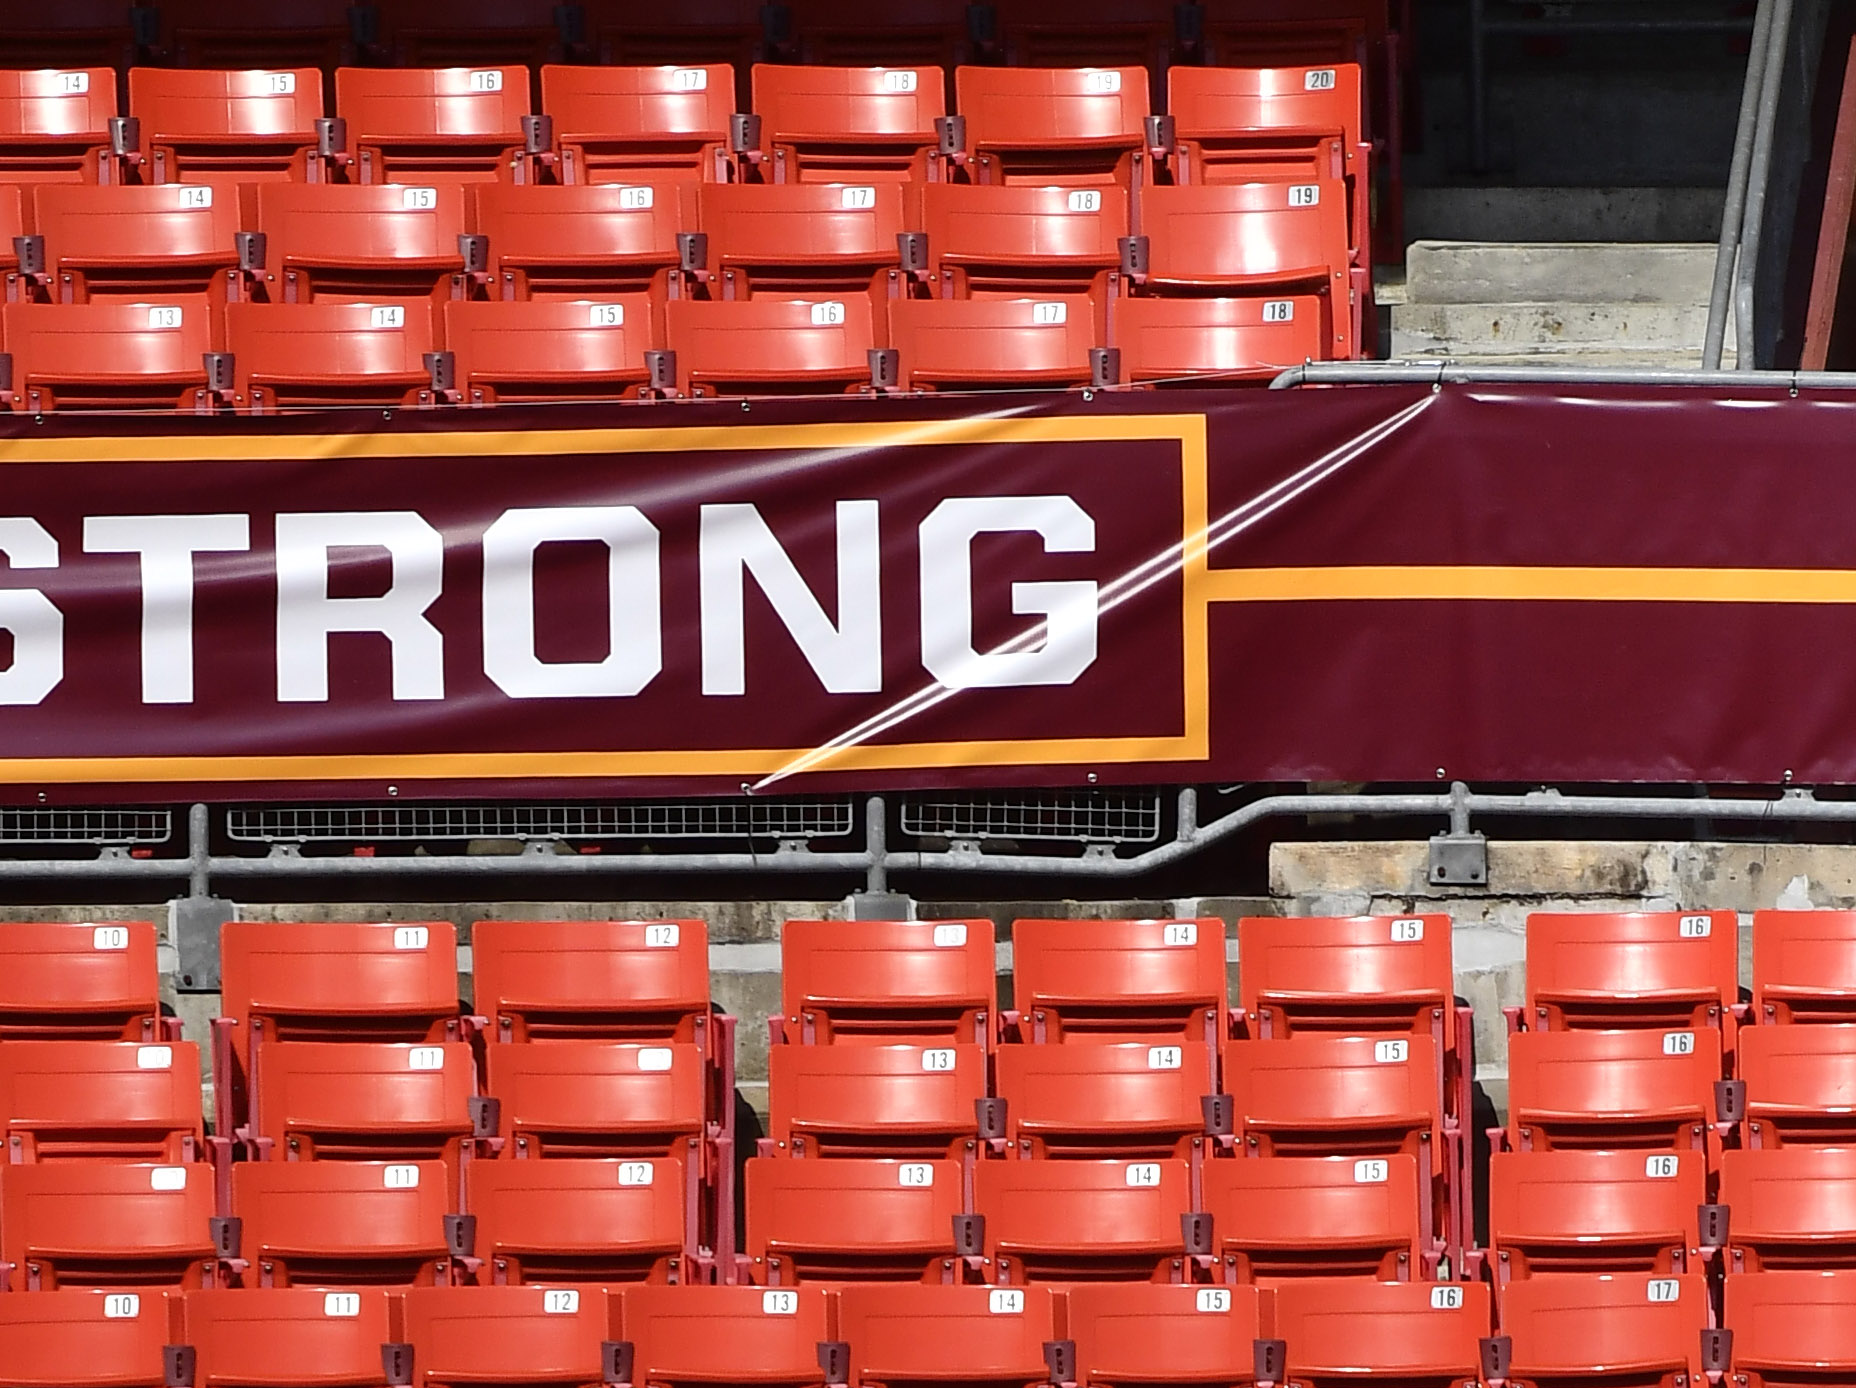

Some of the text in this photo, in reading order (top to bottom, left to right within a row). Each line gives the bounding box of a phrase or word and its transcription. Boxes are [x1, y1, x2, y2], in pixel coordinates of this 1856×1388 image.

[683, 72, 699, 88] 17
[1311, 72, 1330, 88] 20
[187, 189, 205, 205] 14
[412, 191, 429, 206] 15
[851, 190, 867, 206] 17
[1296, 187, 1313, 204] 19
[380, 309, 396, 325] 14
[599, 307, 616, 324] 15
[1270, 303, 1287, 320] 18
[1173, 927, 1189, 943] 14
[1399, 922, 1416, 939] 15
[1687, 918, 1704, 935] 16
[404, 930, 419, 946] 11
[1670, 1035, 1688, 1052] 16
[931, 1052, 948, 1069] 13
[907, 1166, 925, 1184] 13
[1135, 1166, 1152, 1183] 14
[1654, 1158, 1671, 1175] 16
[1438, 1289, 1456, 1306] 16
[1655, 1282, 1672, 1300] 17
[114, 1297, 132, 1315] 10
[335, 1296, 351, 1313] 11
[553, 1292, 571, 1311] 12
[772, 1293, 789, 1312] 13
[999, 1293, 1016, 1310] 14
[1205, 1291, 1223, 1310] 15
